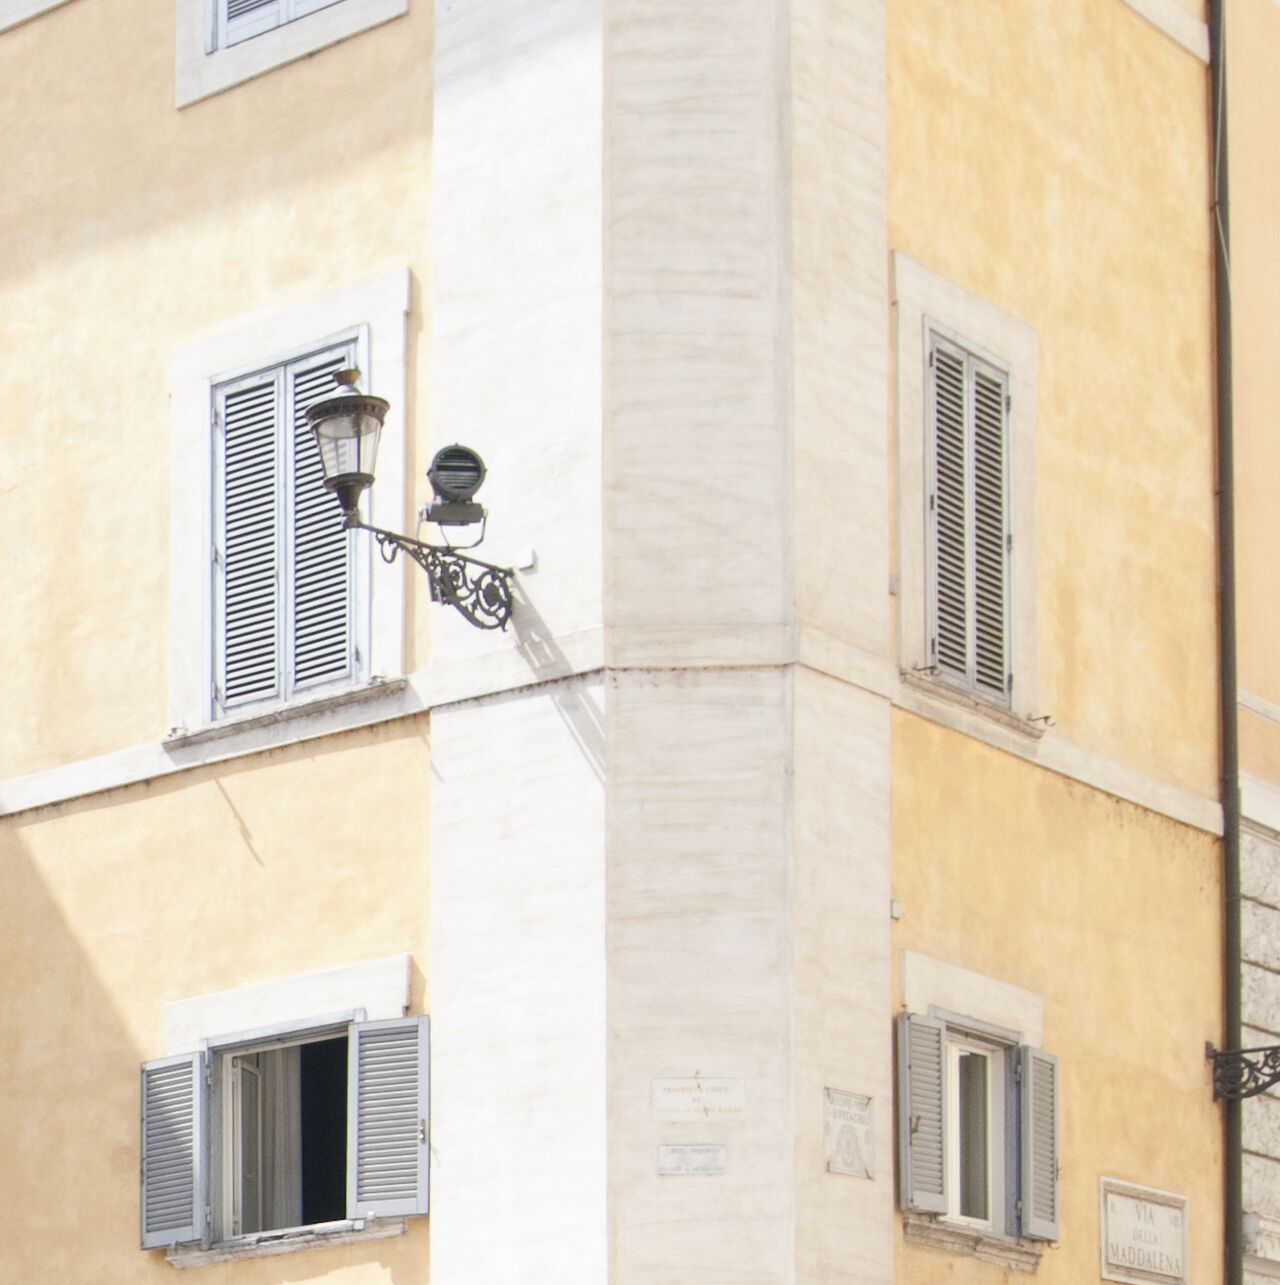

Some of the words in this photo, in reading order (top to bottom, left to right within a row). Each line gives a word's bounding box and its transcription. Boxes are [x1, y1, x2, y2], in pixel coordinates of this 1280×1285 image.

[1135, 1203, 1155, 1227] VIA
[1132, 1227, 1158, 1245] DELLA
[1110, 1242, 1182, 1275] MADDALENA
